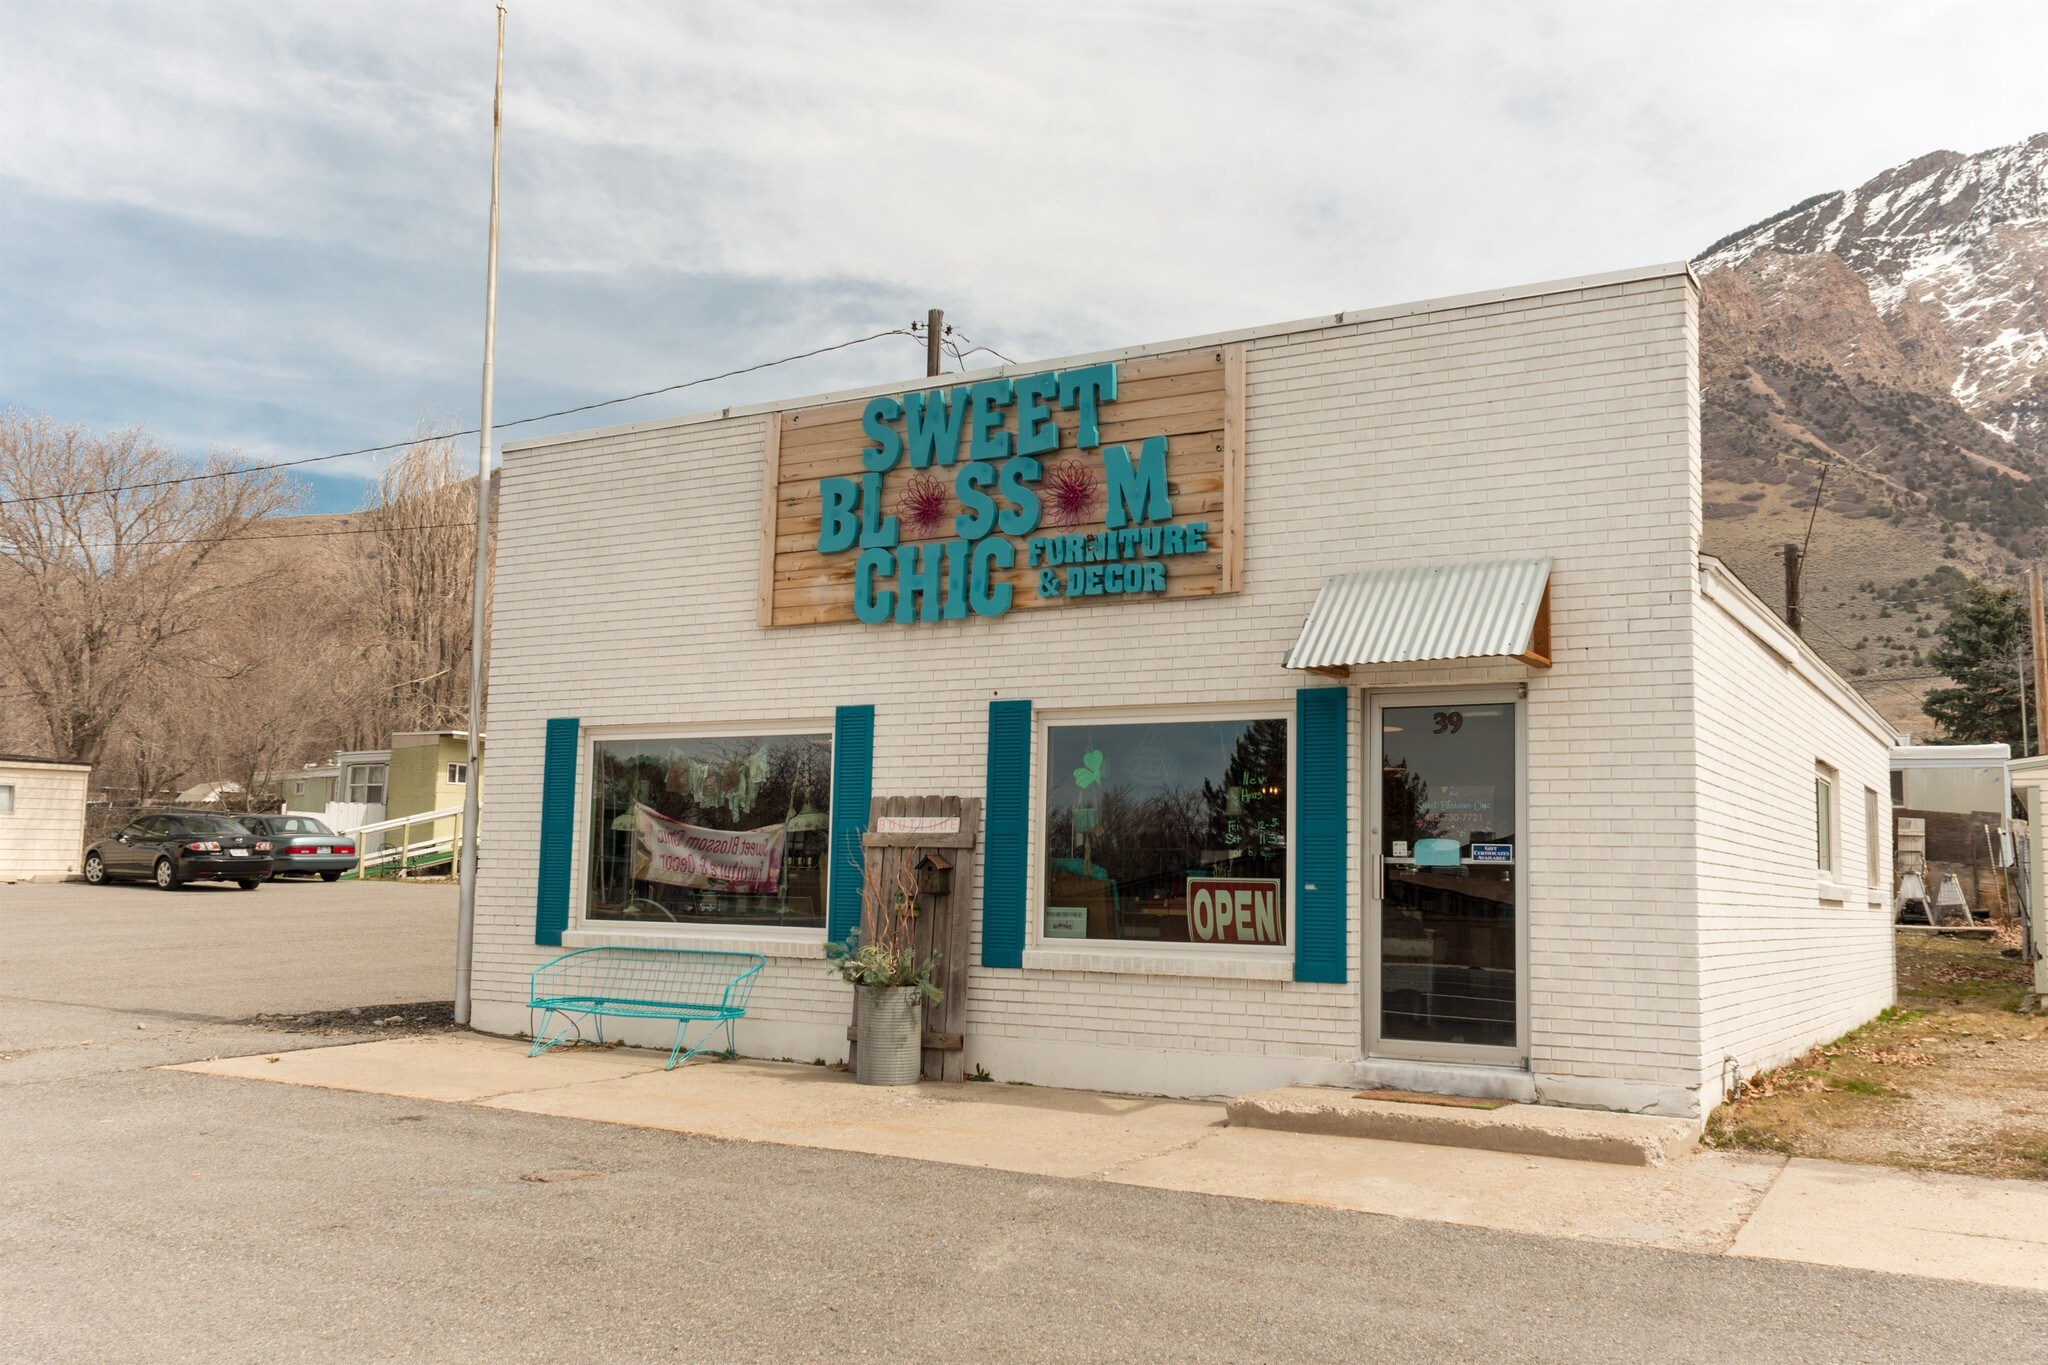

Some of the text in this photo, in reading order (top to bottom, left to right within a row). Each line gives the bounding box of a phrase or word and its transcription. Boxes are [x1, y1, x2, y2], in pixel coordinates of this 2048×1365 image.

[863, 363, 1118, 472] SWEET
[1027, 522, 1208, 567] FURNITURE
[854, 536, 1015, 624] CHIC
[1037, 561, 1167, 598] & DECOR
[1433, 711, 1463, 735] 39
[1193, 888, 1277, 942] OPEN
